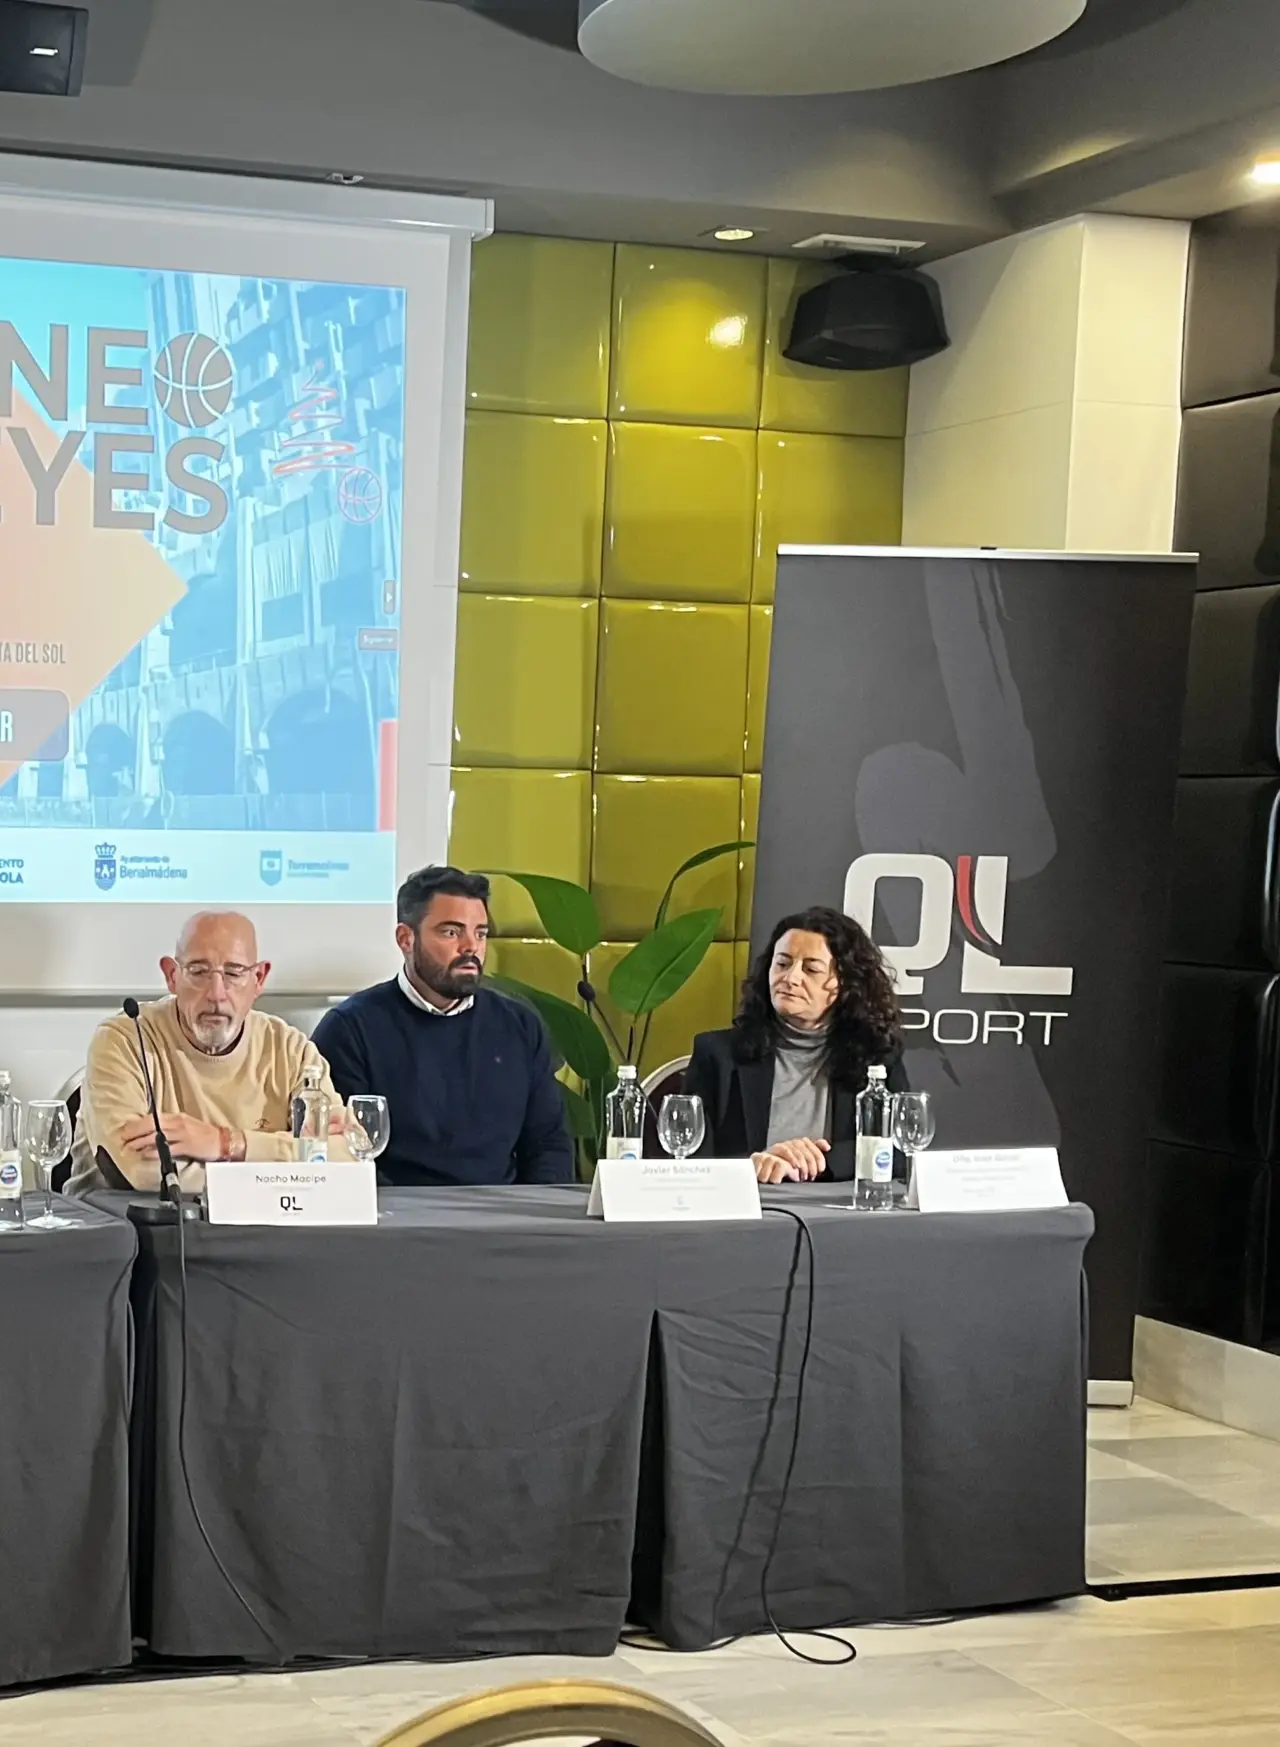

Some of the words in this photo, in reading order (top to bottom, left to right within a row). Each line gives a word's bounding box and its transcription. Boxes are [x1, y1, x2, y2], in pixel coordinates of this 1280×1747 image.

[15, 641, 39, 664] DEL
[42, 642, 66, 665] SOL
[843, 853, 1074, 996] QL
[900, 1009, 1069, 1045] PORT
[255, 1174, 288, 1184] Nacho
